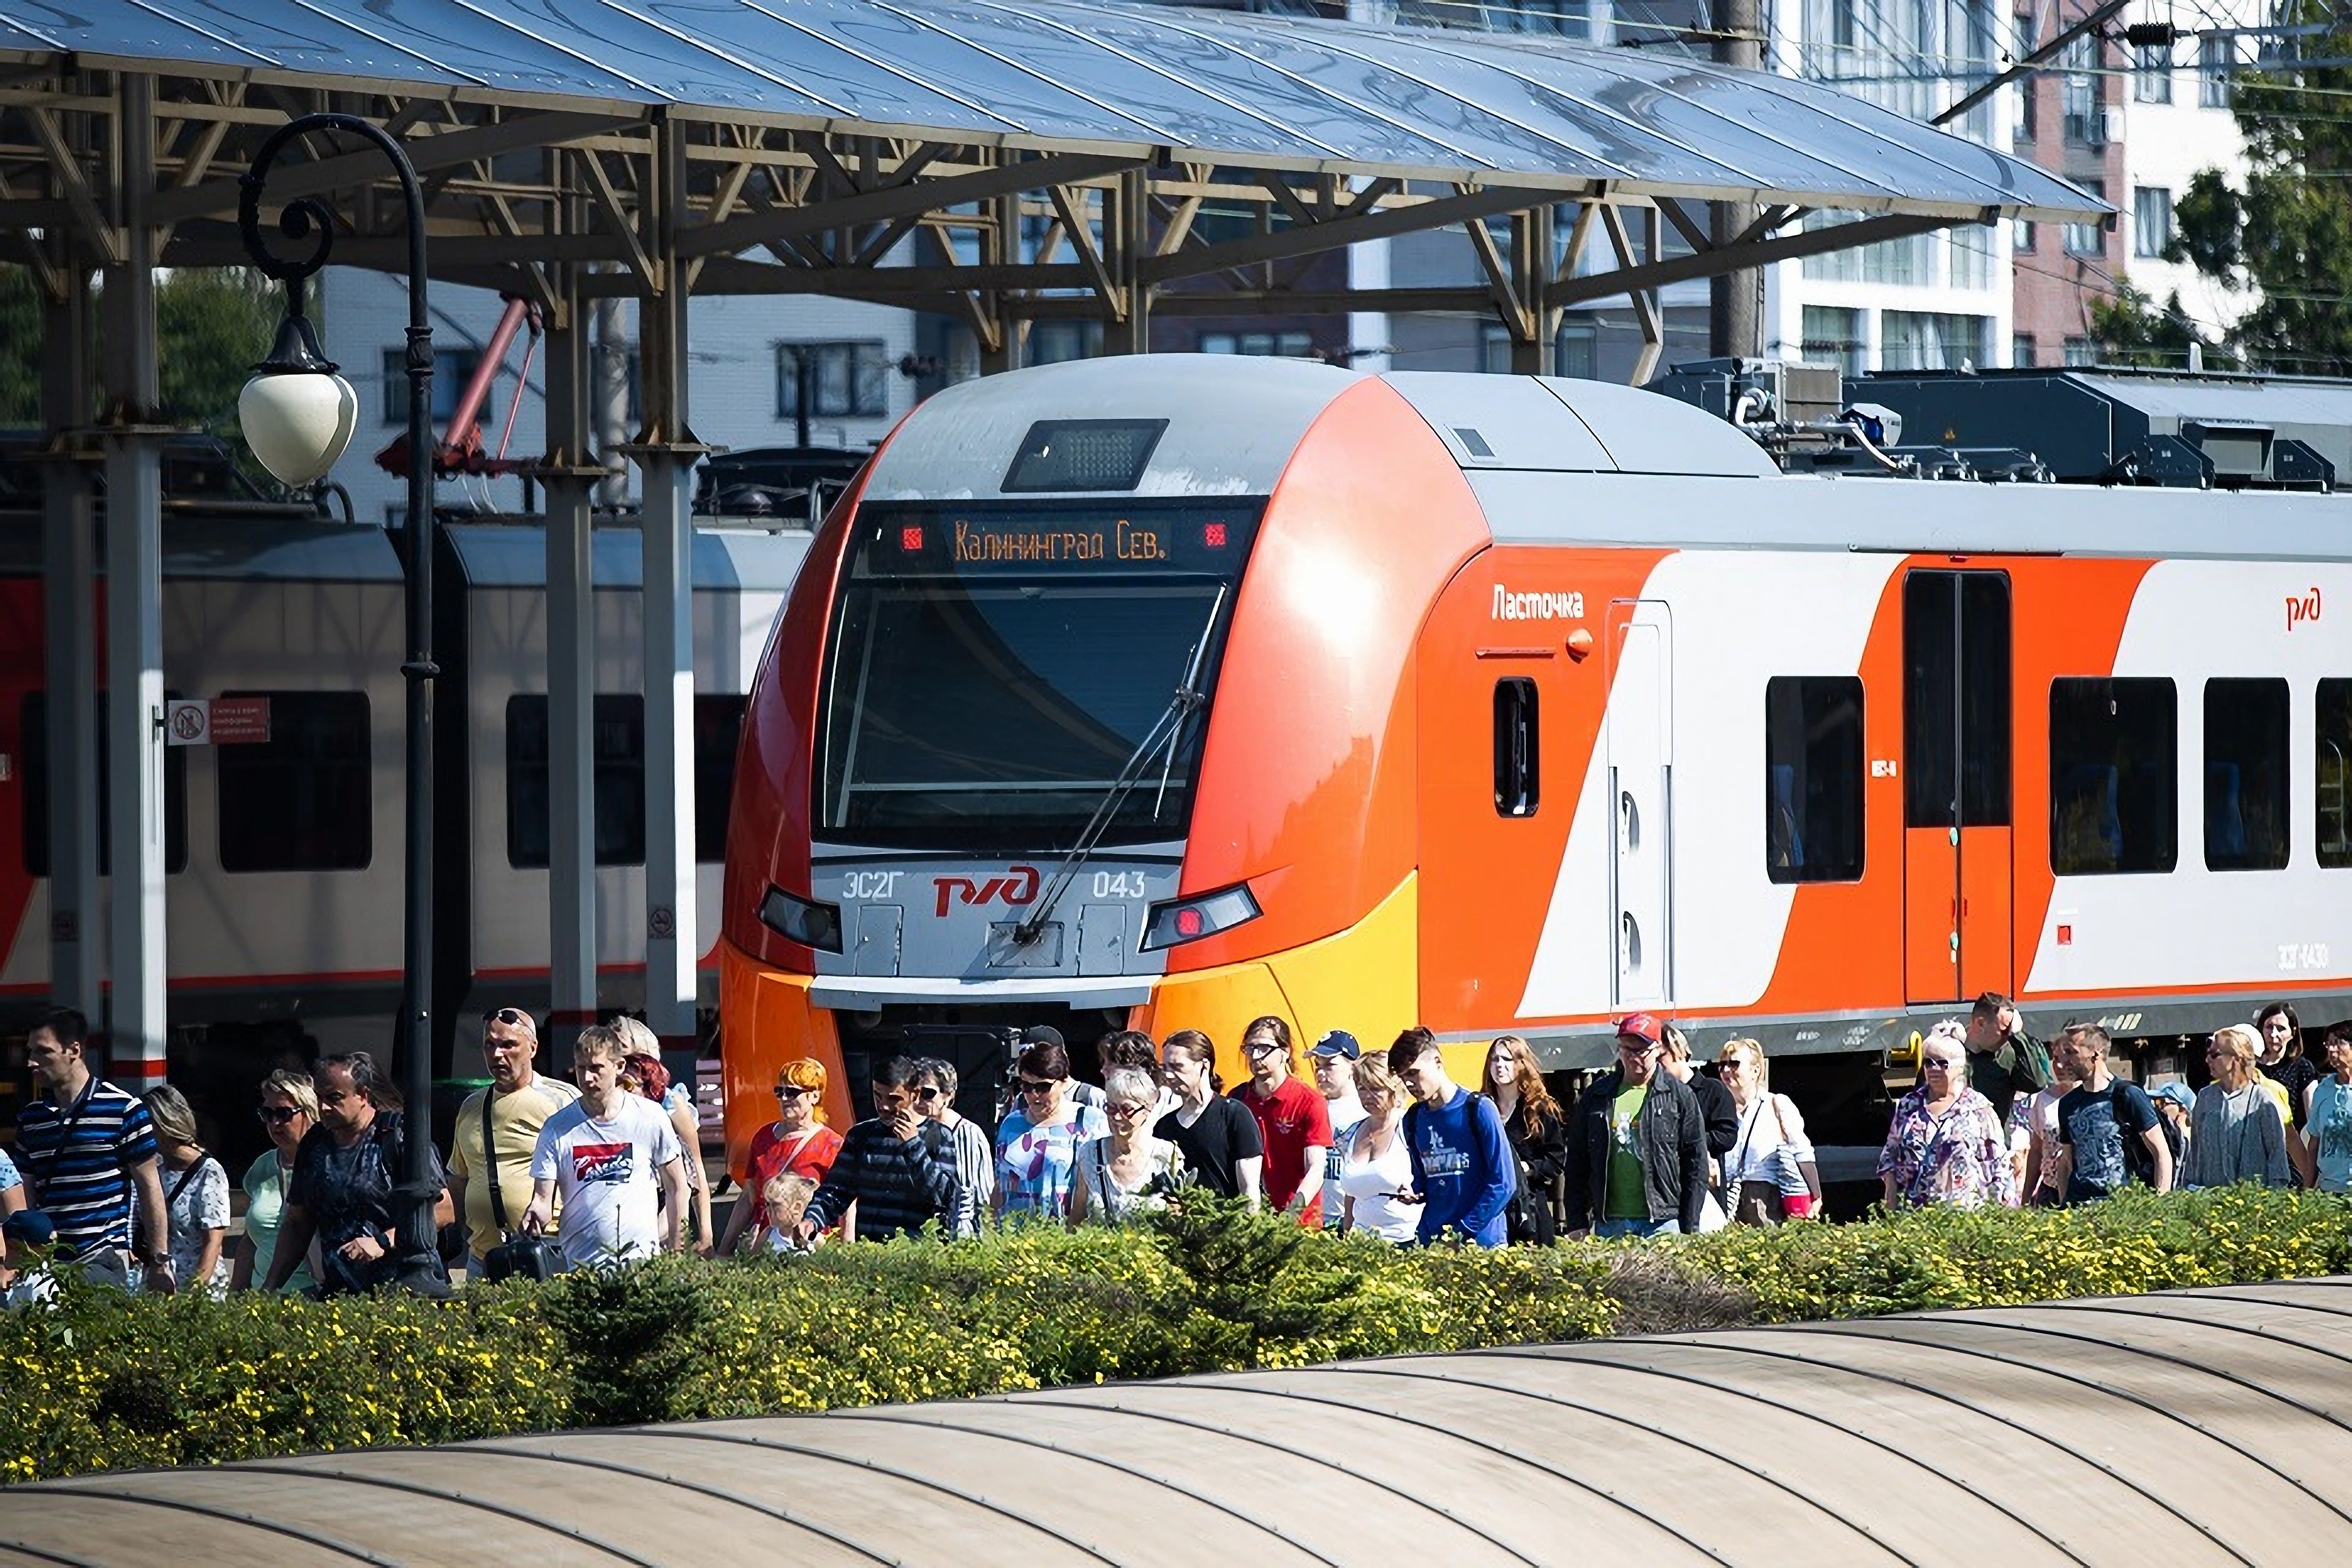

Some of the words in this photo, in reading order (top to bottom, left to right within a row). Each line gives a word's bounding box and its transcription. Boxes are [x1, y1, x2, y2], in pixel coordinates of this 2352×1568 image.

[956, 521, 1104, 560] Калининград
[1117, 519, 1166, 560] Сев.
[1491, 583, 1584, 620] Ласточка
[842, 871, 905, 899] ЭС2Г
[1093, 871, 1146, 899] 043
